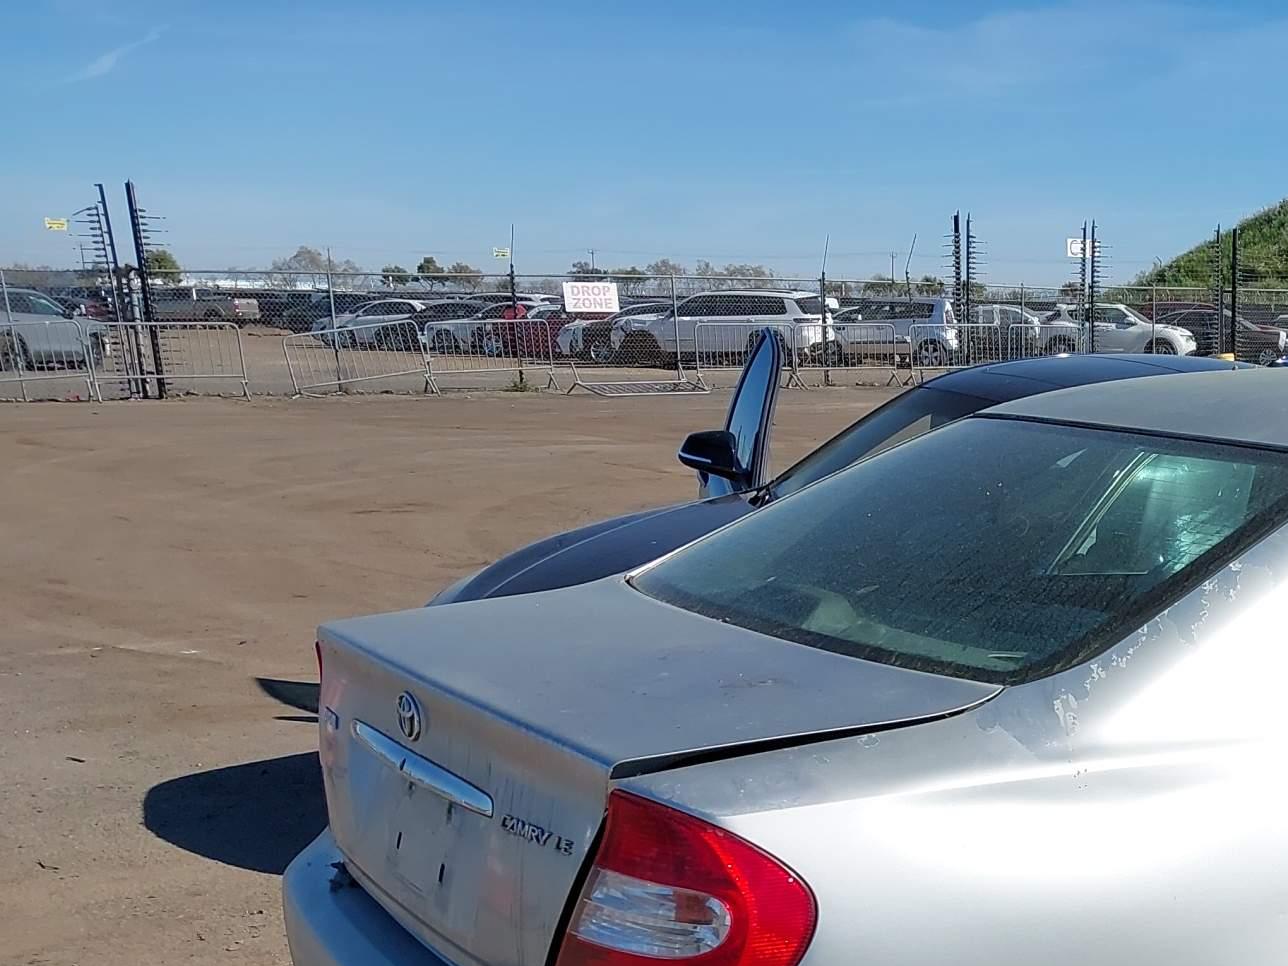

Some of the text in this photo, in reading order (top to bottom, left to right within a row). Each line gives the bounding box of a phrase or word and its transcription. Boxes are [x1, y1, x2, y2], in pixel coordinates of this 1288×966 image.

[570, 285, 611, 297] DROP
[571, 298, 613, 309] ZONE
[501, 814, 574, 856] CAMRY LE
